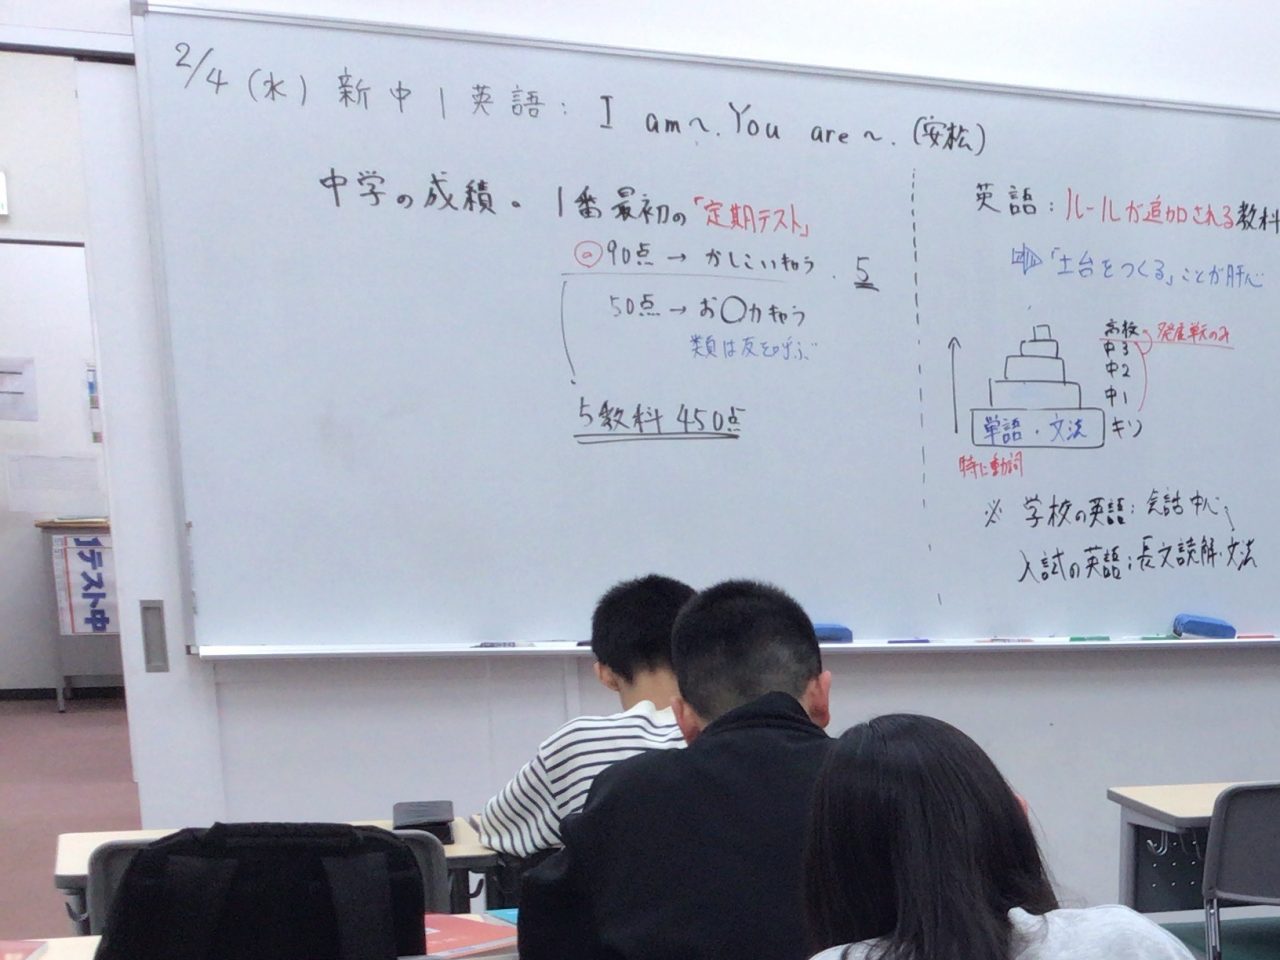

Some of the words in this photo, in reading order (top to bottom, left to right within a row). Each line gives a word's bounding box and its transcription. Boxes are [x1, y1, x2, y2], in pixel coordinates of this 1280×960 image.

[175, 42, 228, 95] 2/4
[248, 67, 307, 106] (水)
[600, 95, 614, 129] I
[728, 101, 781, 141] You
[855, 255, 871, 284] 5
[1103, 340, 1130, 358] 中3
[1105, 359, 1132, 379] 中2
[1104, 384, 1129, 408] 中1
